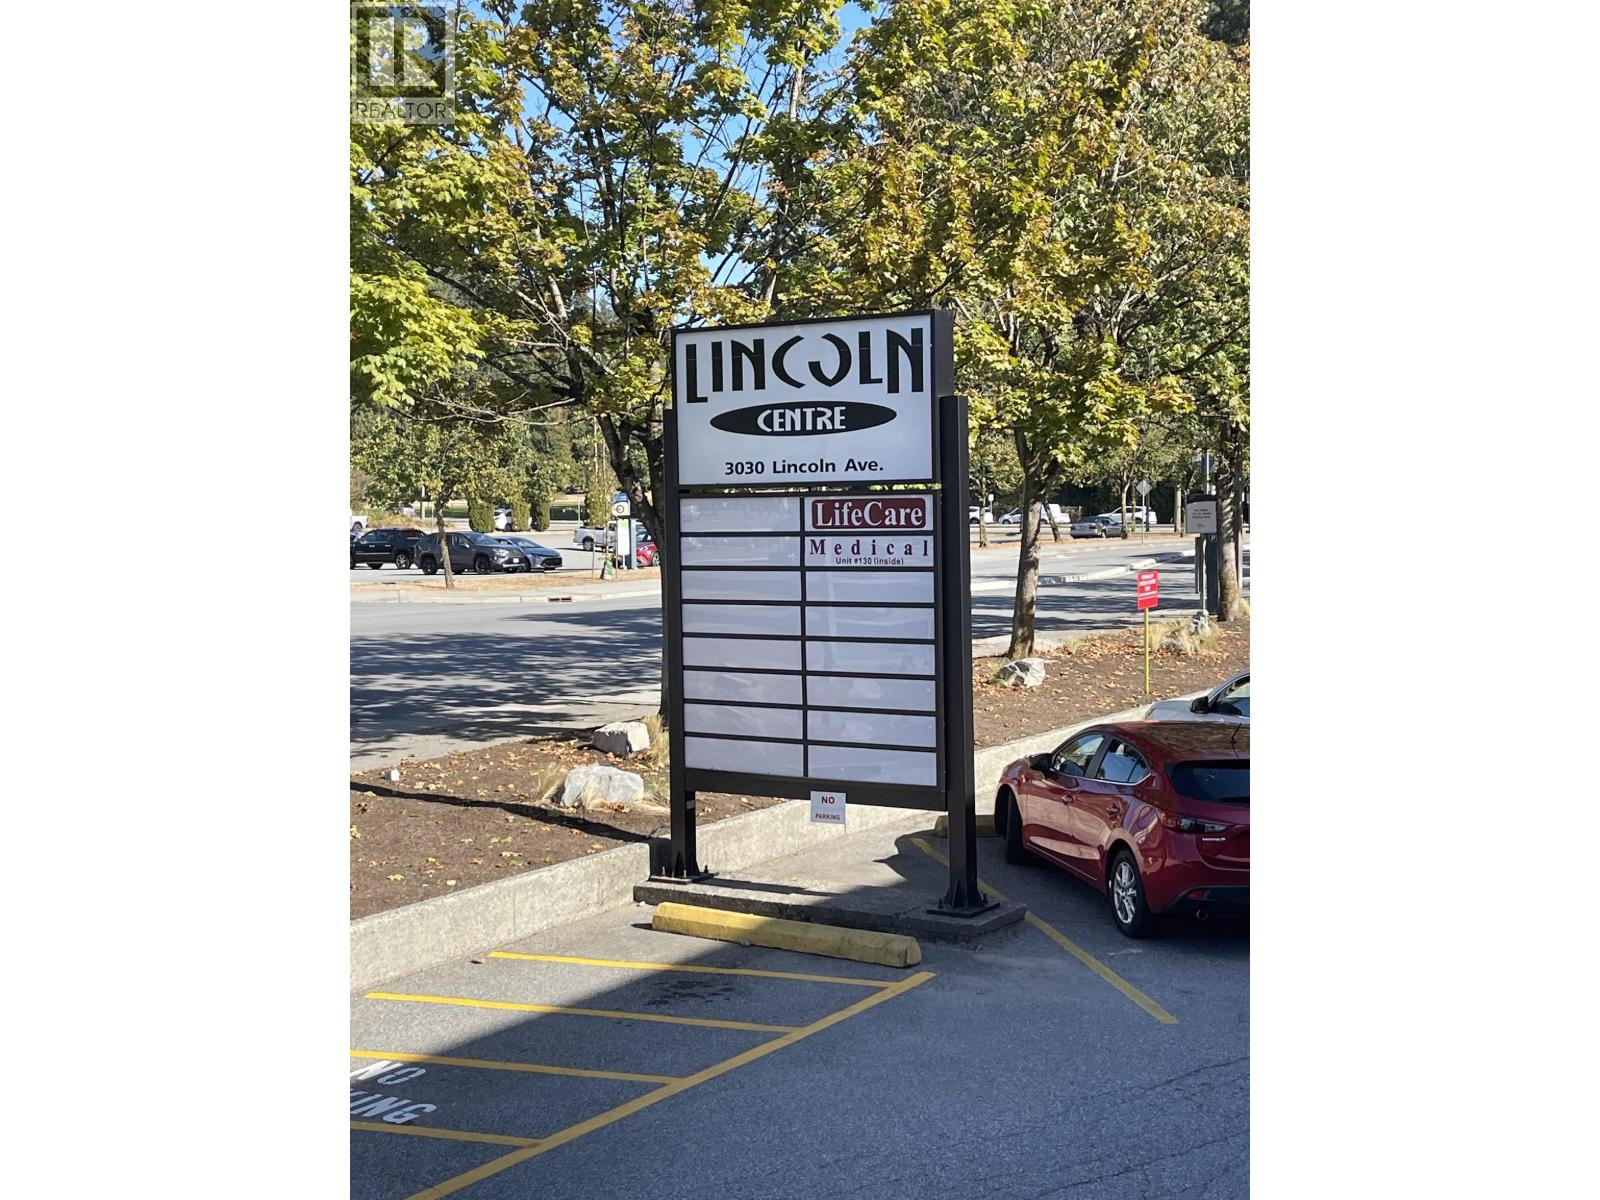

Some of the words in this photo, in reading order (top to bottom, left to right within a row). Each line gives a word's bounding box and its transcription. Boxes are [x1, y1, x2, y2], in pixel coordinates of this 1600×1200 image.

[685, 327, 924, 403] LINCOLN
[757, 406, 846, 433] CENTRE
[725, 461, 765, 475] 3030
[773, 459, 836, 474] Lincoln
[845, 458, 884, 472] Ave.
[816, 501, 923, 527] LifeCare
[810, 539, 928, 556] Medical
[836, 557, 852, 565] Unit
[854, 557, 872, 565] #130
[874, 557, 904, 566] (inside)
[821, 796, 835, 804] NO
[815, 813, 841, 821] PARKING
[350, 1060, 427, 1085] NO
[350, 1088, 437, 1124] ING
